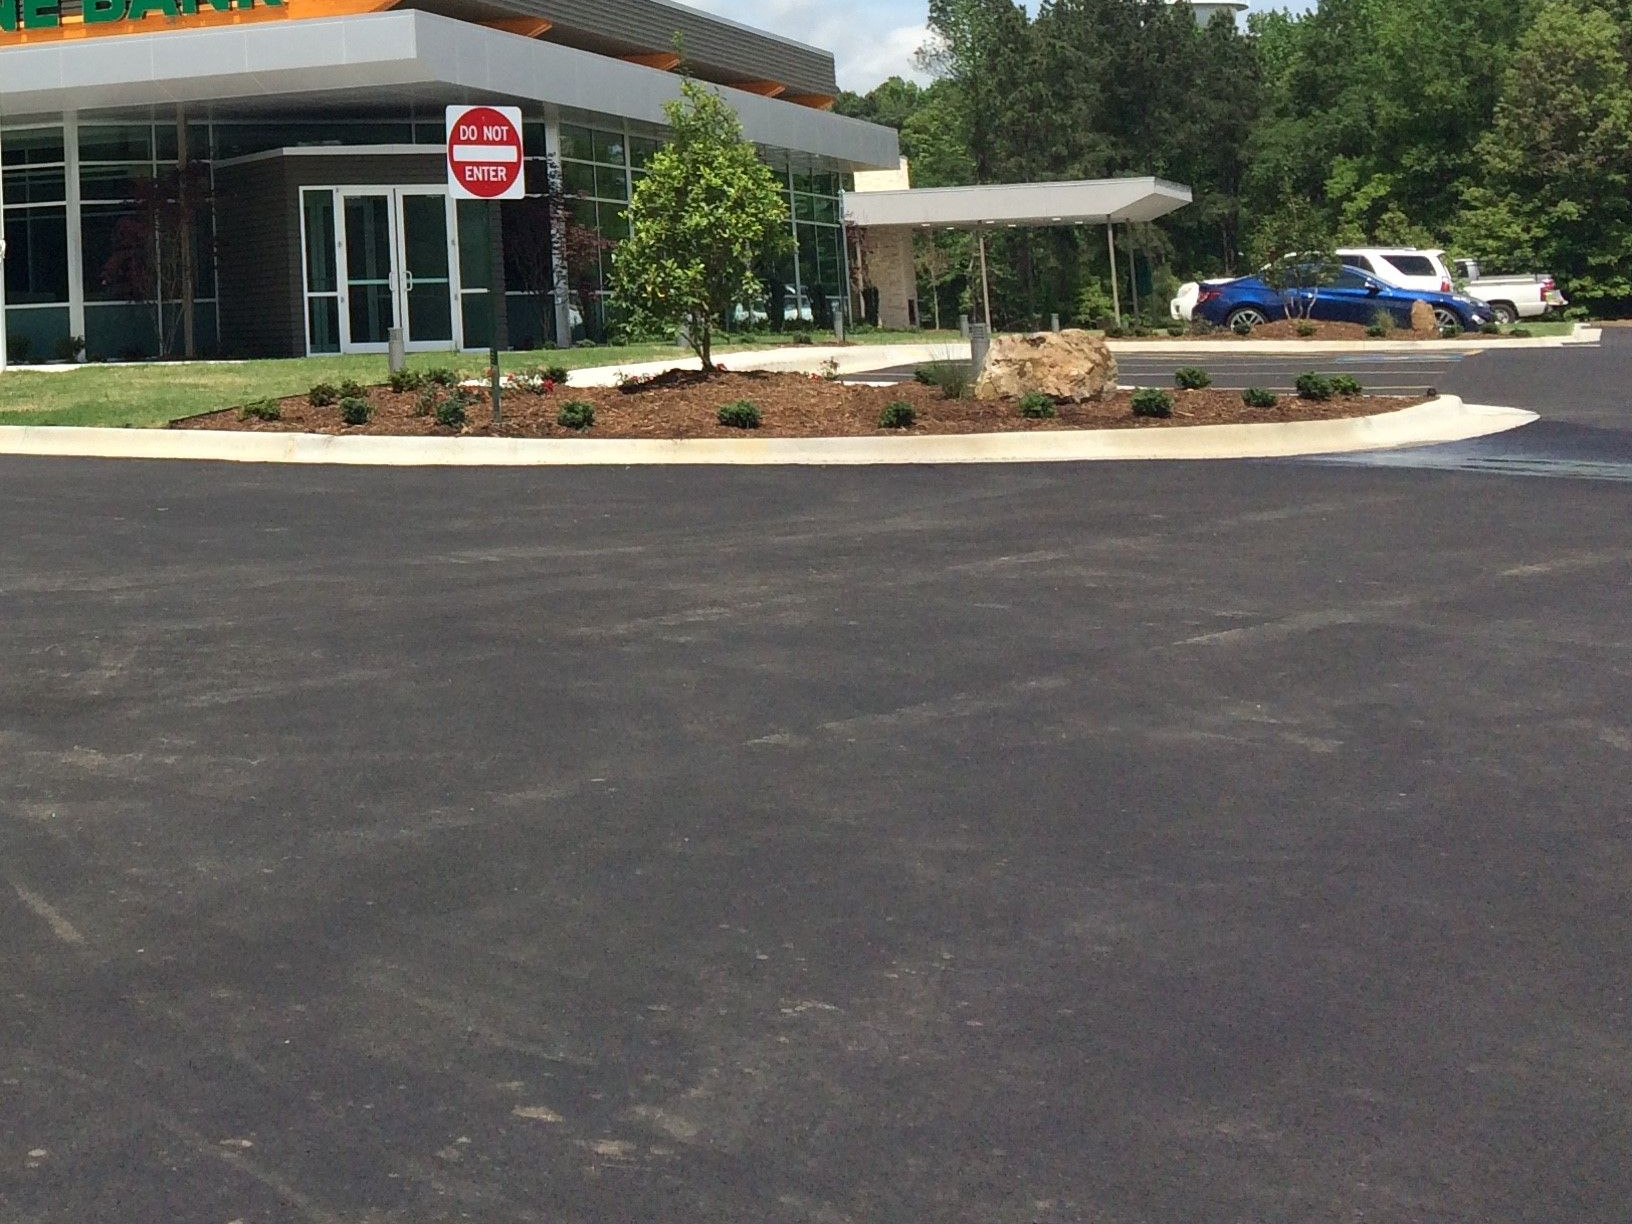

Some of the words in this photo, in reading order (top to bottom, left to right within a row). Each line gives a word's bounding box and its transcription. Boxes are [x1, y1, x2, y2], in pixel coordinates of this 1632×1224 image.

[459, 125, 478, 141] DO
[483, 126, 509, 141] NOT
[465, 166, 507, 181] ENTER
